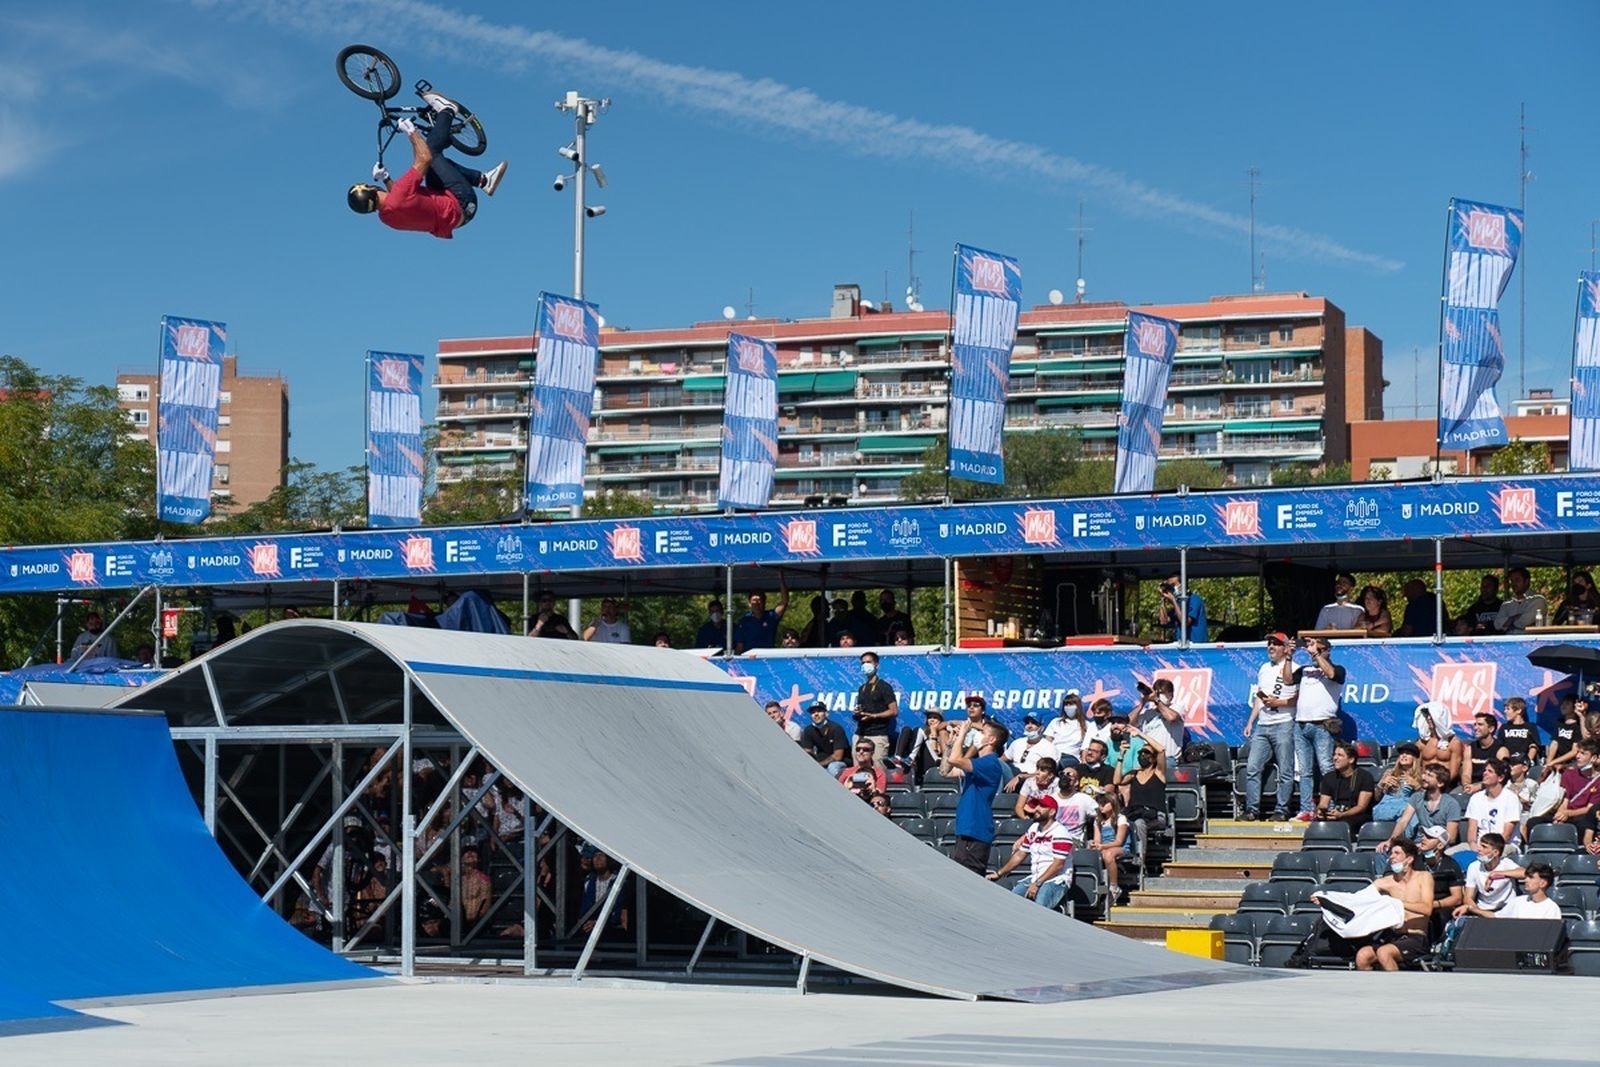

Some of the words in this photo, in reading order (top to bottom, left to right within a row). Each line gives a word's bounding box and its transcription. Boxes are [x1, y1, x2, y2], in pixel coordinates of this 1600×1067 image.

[1453, 428, 1499, 442] MADRID
[960, 462, 997, 475] MADRID
[537, 492, 576, 502] MADRID
[164, 506, 202, 517] MADRID
[1421, 502, 1480, 516] MADRID
[1153, 514, 1206, 528] MADRID
[955, 523, 1007, 535] MADRID
[724, 532, 772, 545] MADRID
[553, 540, 598, 551] MADRID
[351, 549, 392, 560] MADRID
[201, 556, 240, 567] MADRID
[22, 564, 59, 575] MADRID
